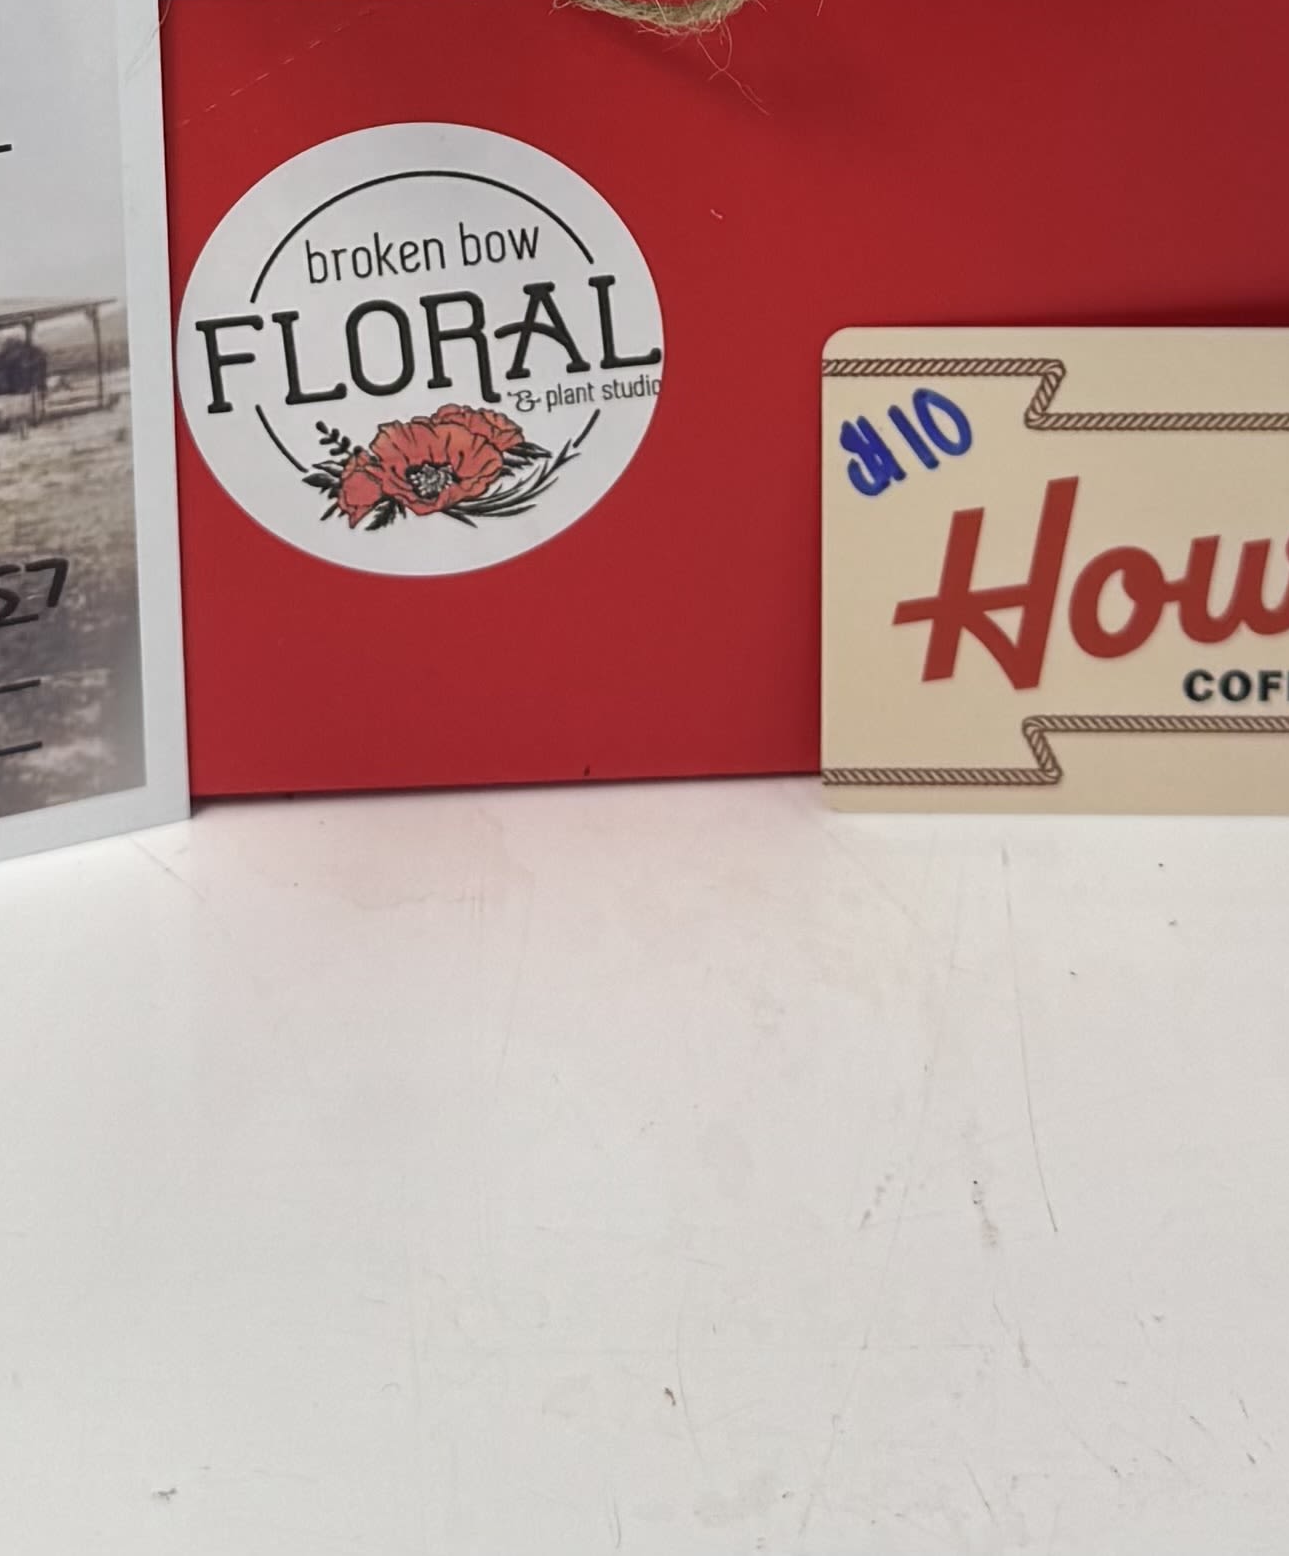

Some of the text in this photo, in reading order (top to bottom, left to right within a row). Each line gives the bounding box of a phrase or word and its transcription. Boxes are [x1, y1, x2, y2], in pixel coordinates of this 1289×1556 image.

[306, 222, 540, 284] broken bow
[195, 275, 662, 414] FLORAL
[507, 374, 662, 413] & plant studio
[838, 387, 974, 498] $10
